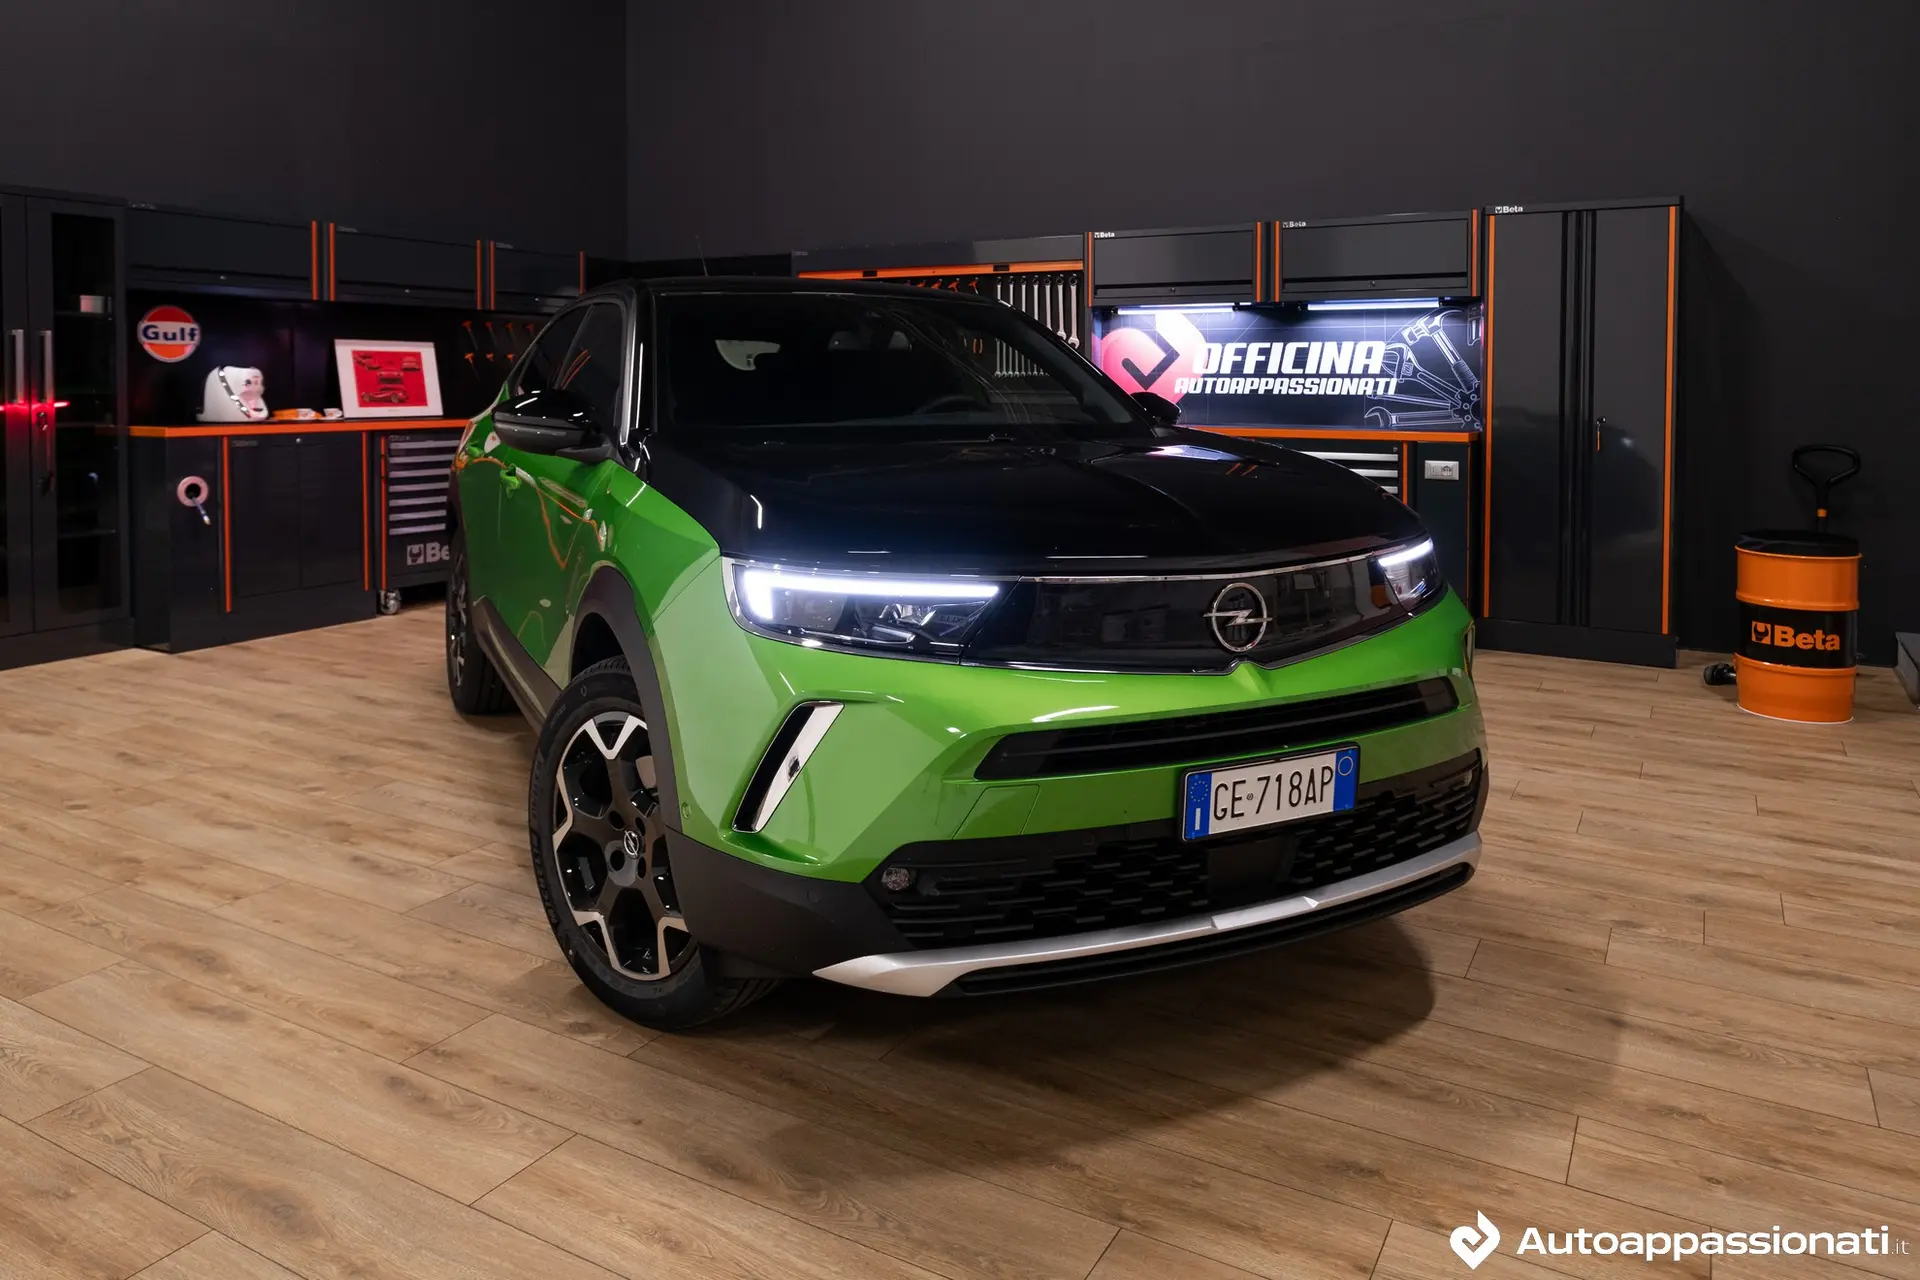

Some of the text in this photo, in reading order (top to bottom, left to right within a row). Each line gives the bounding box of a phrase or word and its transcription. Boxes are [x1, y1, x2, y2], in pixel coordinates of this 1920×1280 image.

[1502, 205, 1524, 214] Beta
[142, 324, 197, 341] Gulf
[1192, 340, 1387, 375] OFFICINA
[1174, 376, 1398, 396] AUTOAPPASSIONATI
[425, 541, 450, 563] Be
[1774, 624, 1841, 651] Beta
